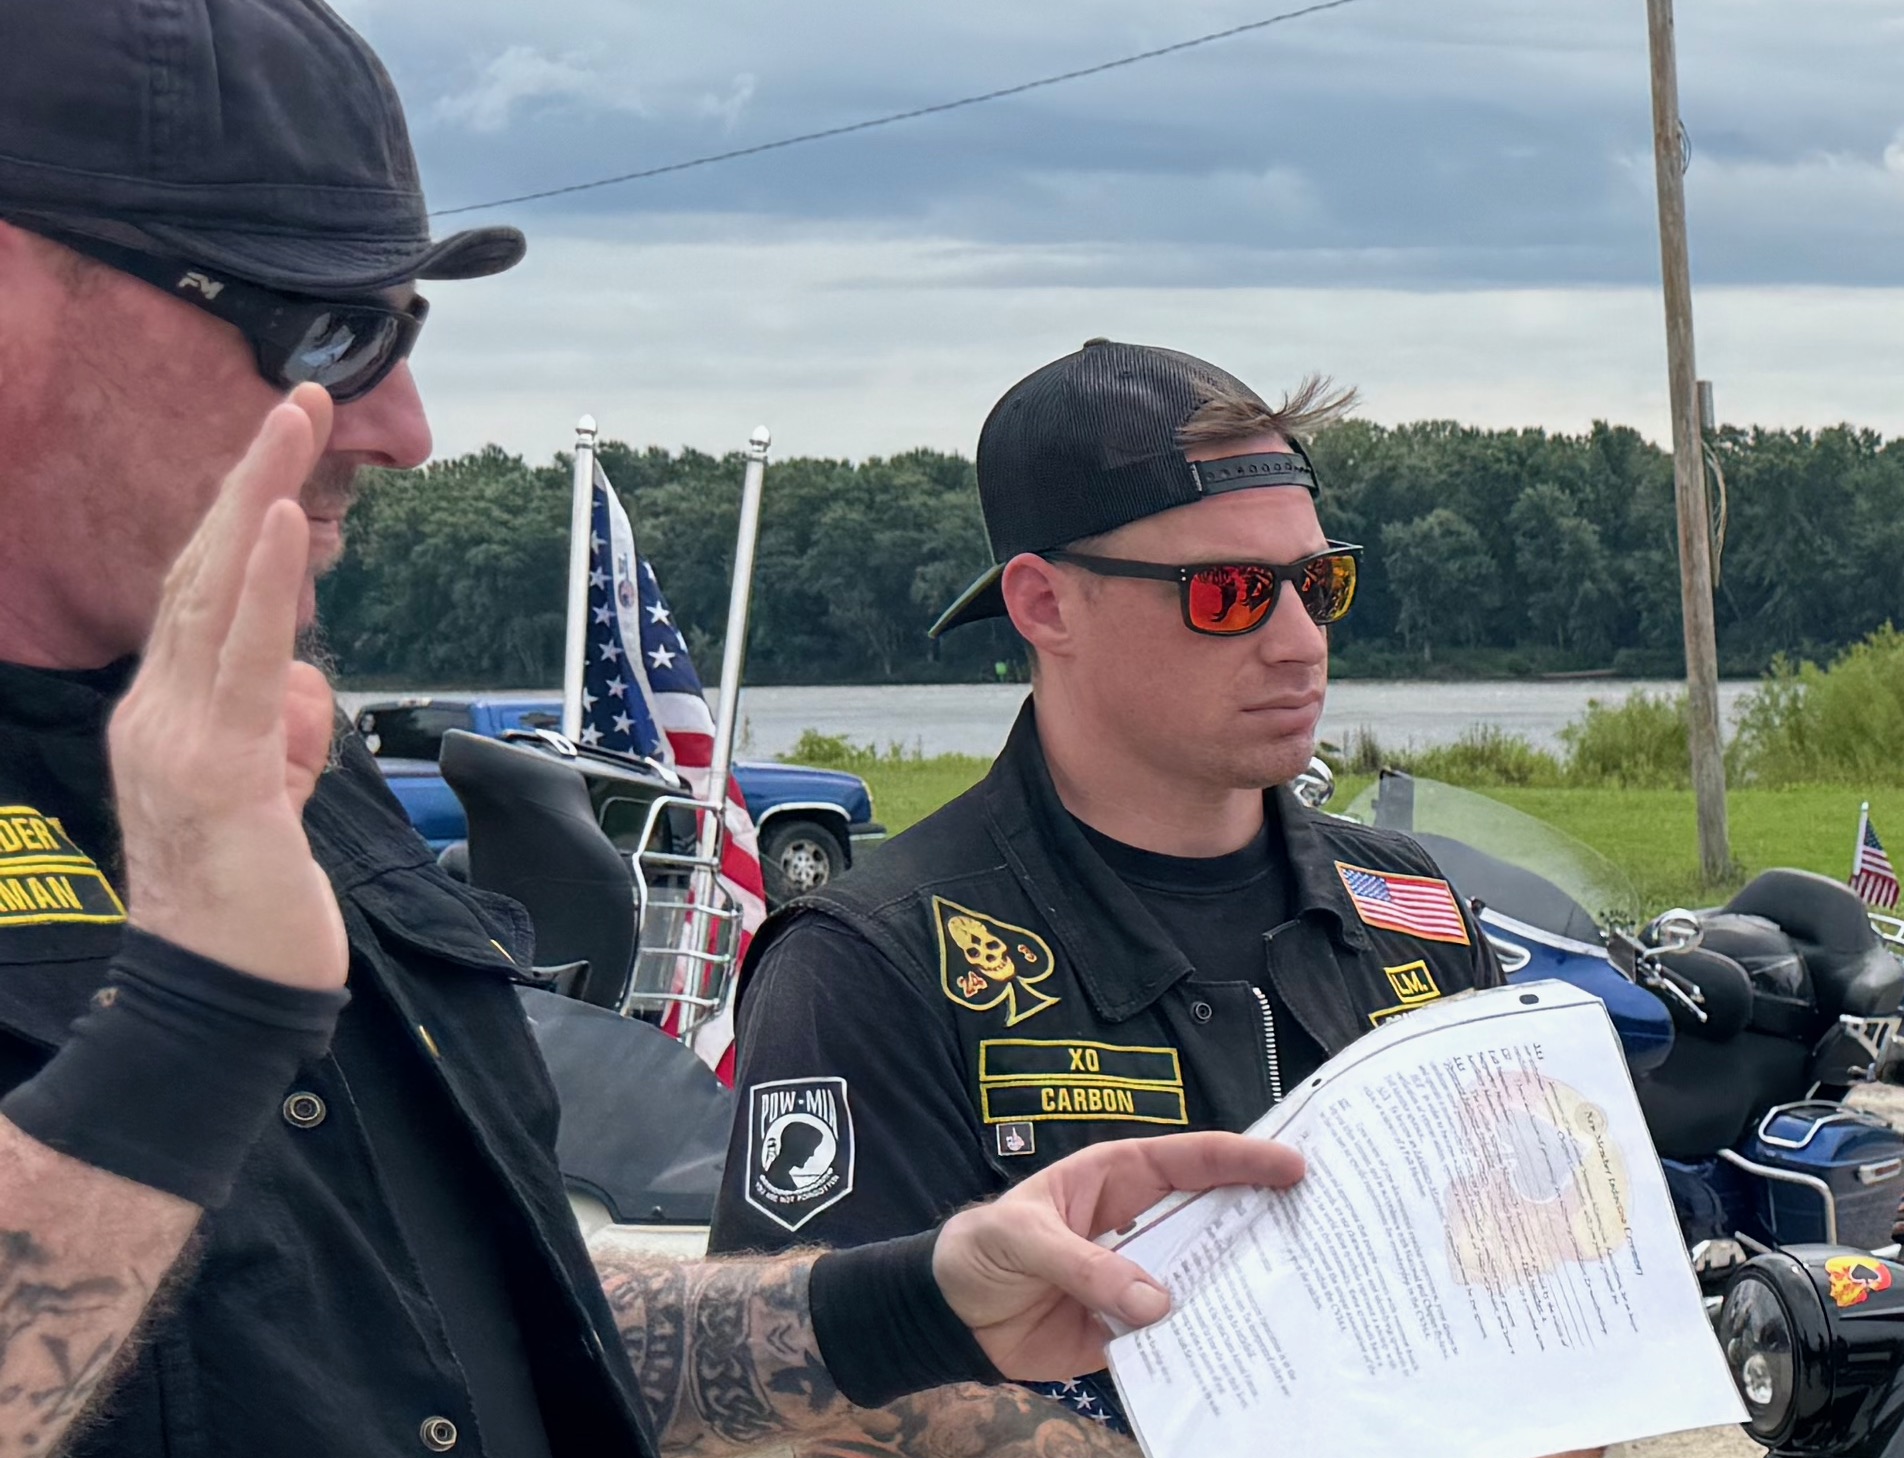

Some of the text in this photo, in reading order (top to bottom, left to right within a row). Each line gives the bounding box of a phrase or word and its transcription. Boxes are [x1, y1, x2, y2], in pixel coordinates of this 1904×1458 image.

[957, 971, 988, 998] 24
[1068, 1048, 1100, 1072] XO
[1041, 1087, 1135, 1113] CARBON
